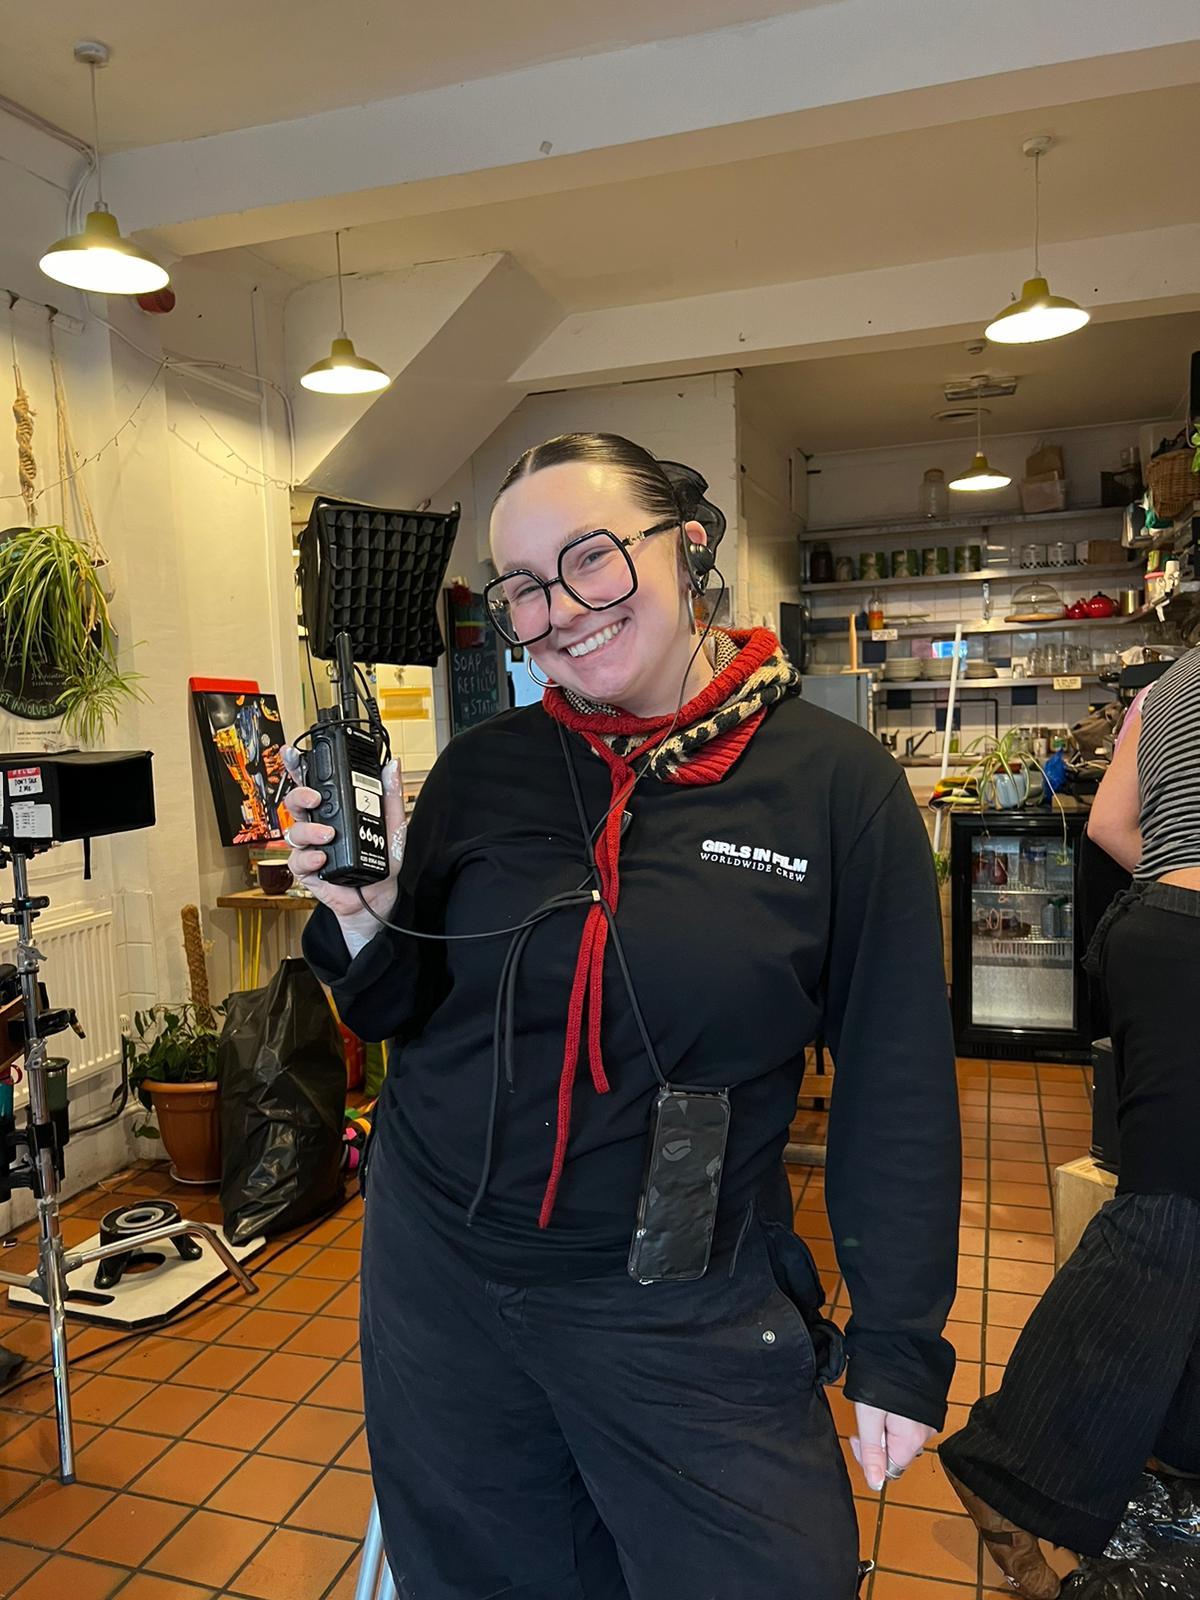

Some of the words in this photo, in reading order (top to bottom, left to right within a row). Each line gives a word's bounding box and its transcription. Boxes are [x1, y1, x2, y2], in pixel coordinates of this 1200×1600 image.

[454, 653, 481, 672] SOAP
[457, 674, 491, 694] REFILL
[10, 699, 56, 716] INVOLVED
[359, 825, 385, 850] 6699
[700, 852, 772, 873] WORLDWIDE
[776, 867, 805, 883] CREW
[702, 839, 752, 859] GIRLS
[752, 847, 772, 863] IN
[772, 852, 808, 873] FILM
[976, 907, 1031, 938] SOFT
